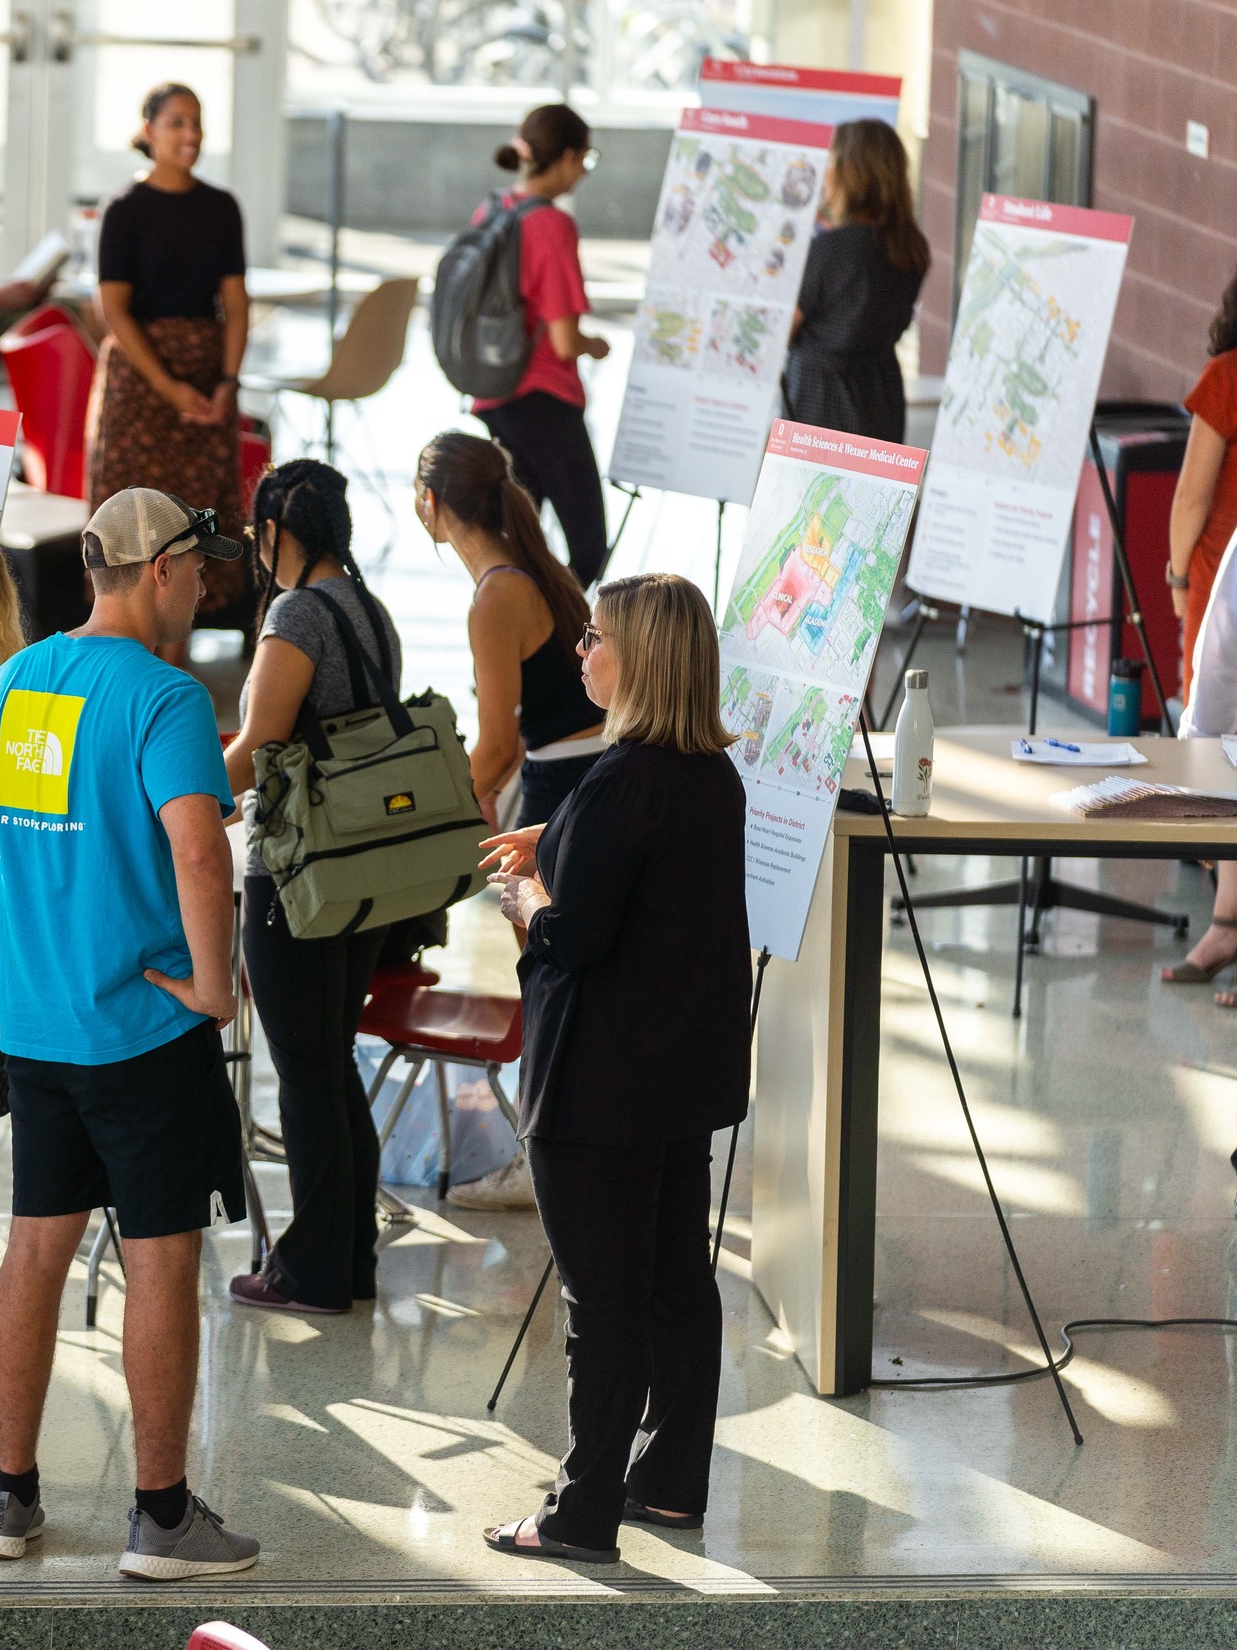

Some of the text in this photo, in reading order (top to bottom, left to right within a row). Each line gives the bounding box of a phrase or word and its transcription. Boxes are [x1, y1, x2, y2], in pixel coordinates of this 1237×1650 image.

[792, 432, 812, 446] Health
[812, 435, 838, 452] Sciences
[838, 441, 844, 453] &
[844, 443, 868, 459] Wexner
[868, 448, 895, 465] Medical
[895, 453, 919, 469] Center
[749, 806, 805, 830] Priority Projects in District
[771, 827, 785, 839] Hospital
[784, 833, 802, 844] Expansion
[749, 839, 806, 863] Health Sciences Academic Buildings
[770, 862, 791, 874] Replacement
[759, 875, 775, 886] Activation
